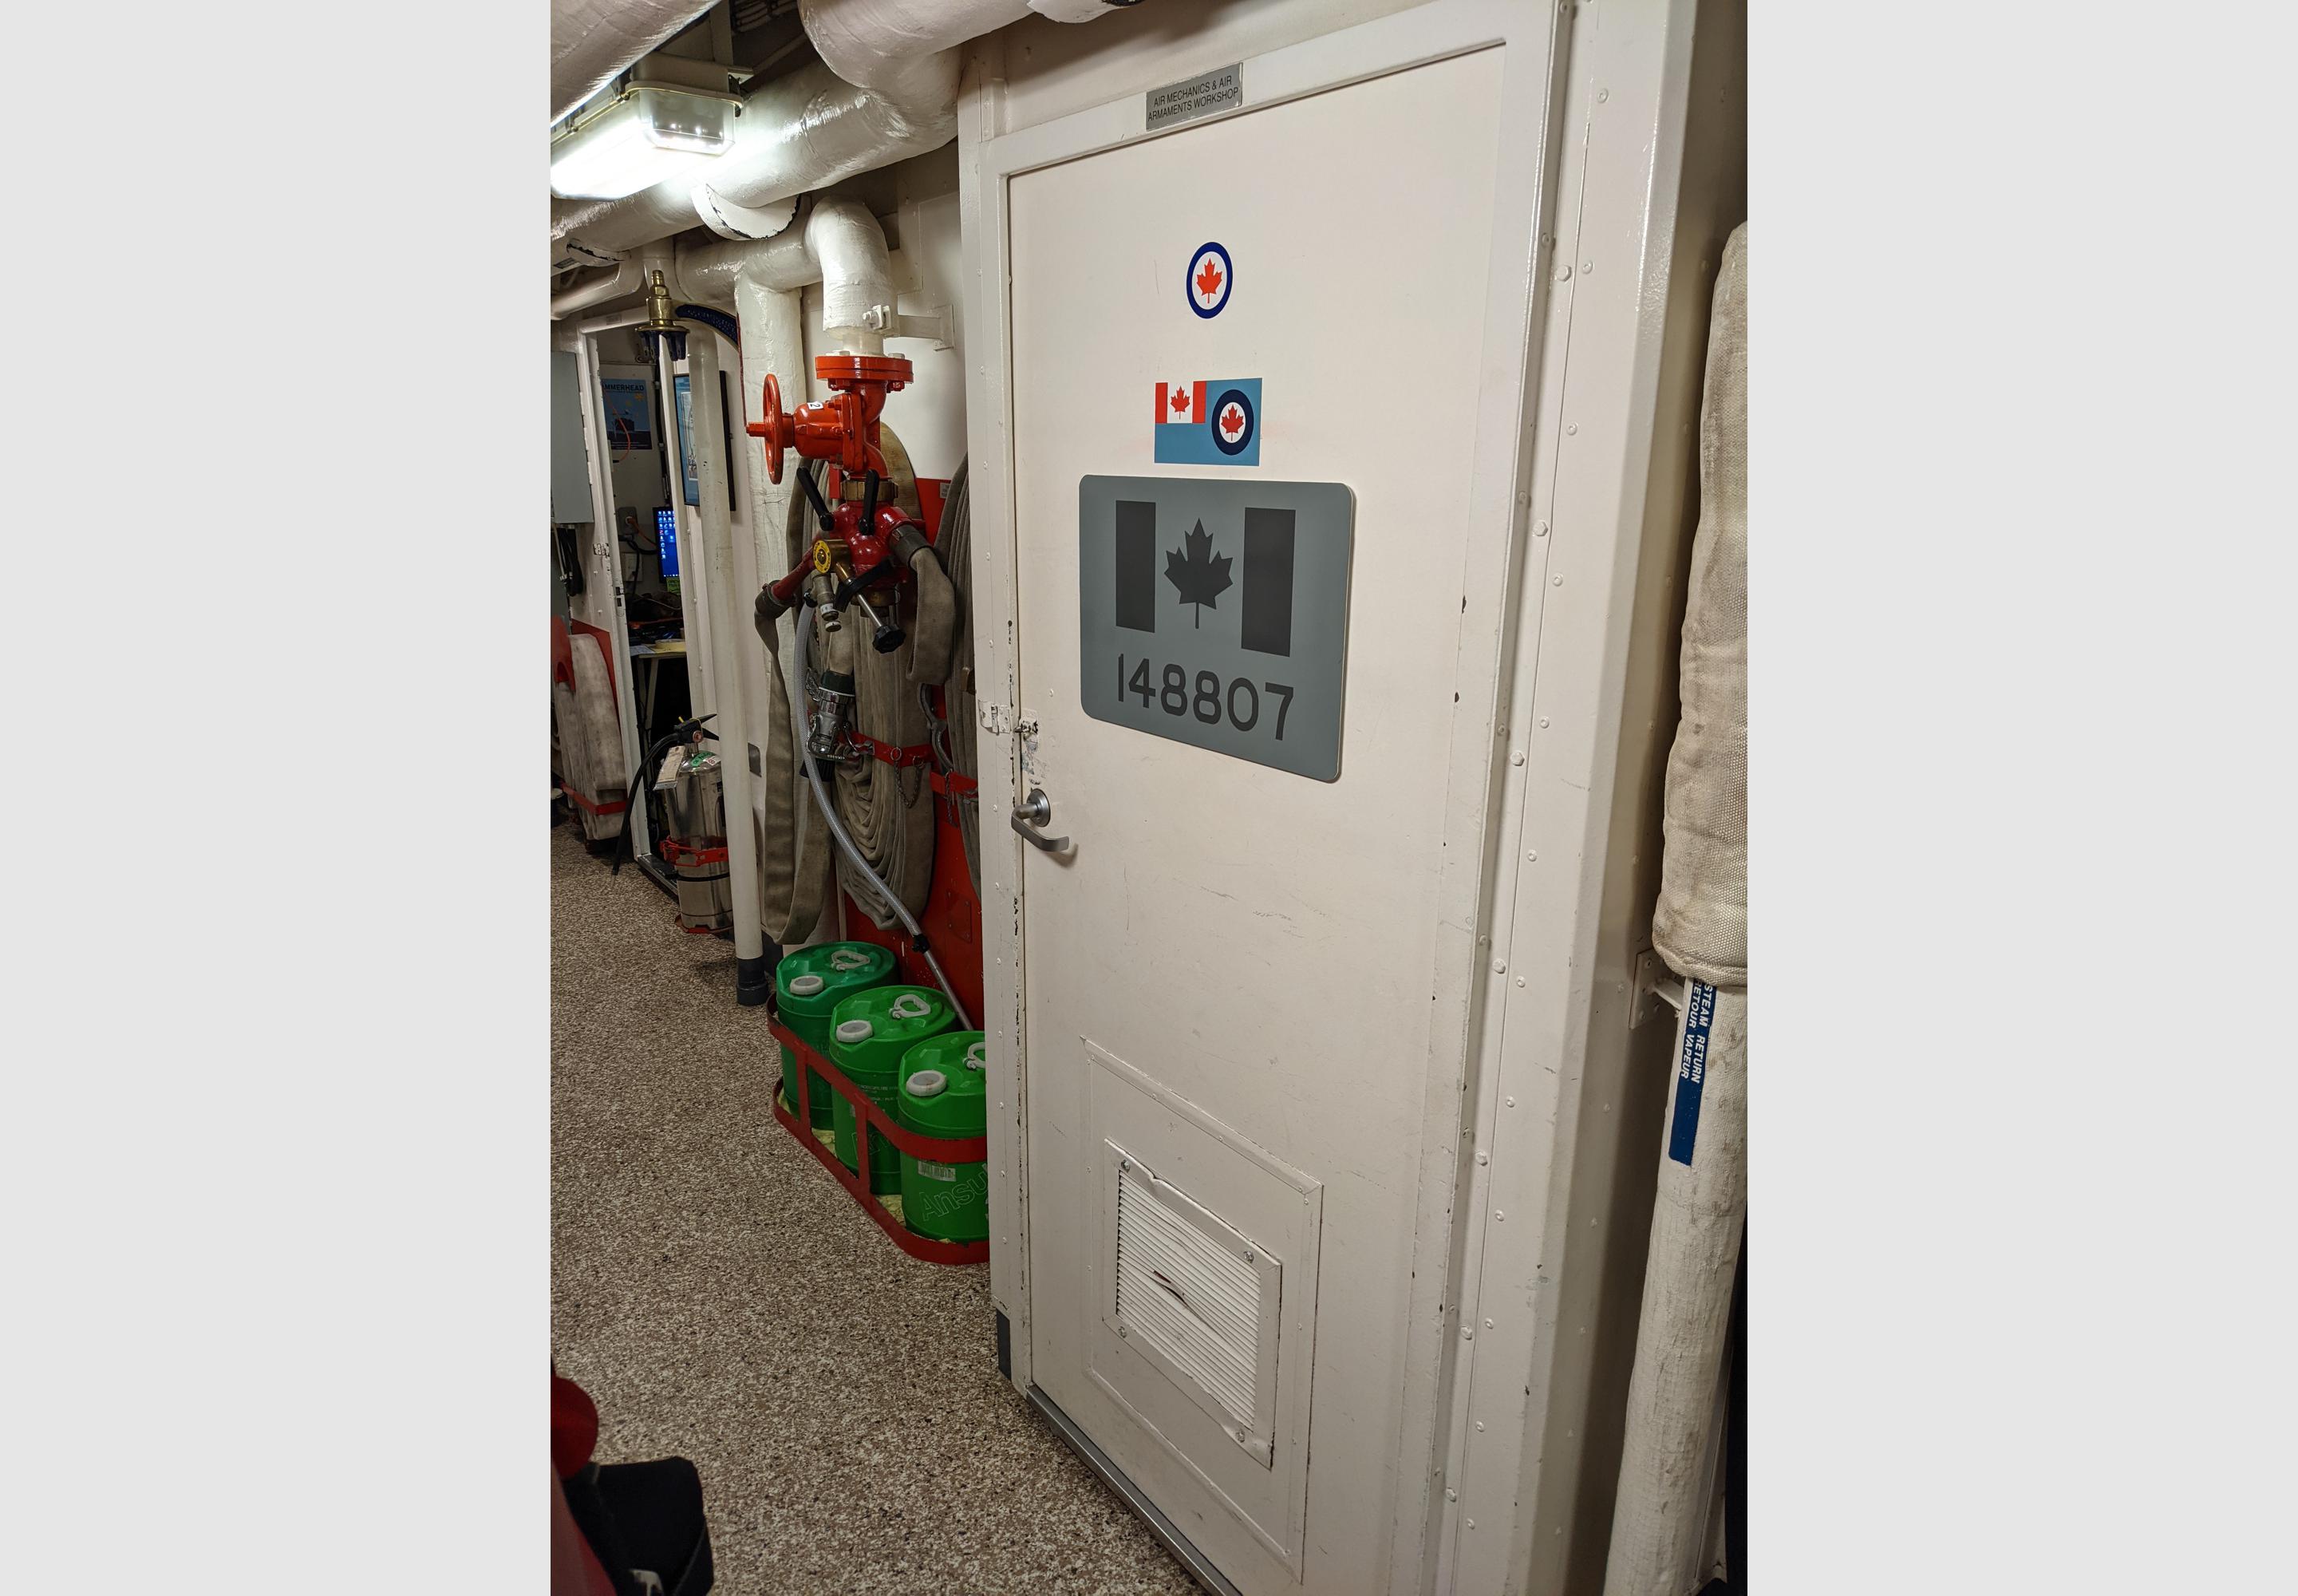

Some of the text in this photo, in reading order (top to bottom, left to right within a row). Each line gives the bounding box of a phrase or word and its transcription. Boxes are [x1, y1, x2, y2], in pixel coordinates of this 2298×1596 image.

[1147, 86, 1238, 121] ARMAMENTS WORKSHOP
[1154, 75, 1232, 107] AIR MECHANICS & AIR
[1118, 654, 1293, 741] 148807
[1680, 1034, 1695, 1080] VAPEUR
[1691, 983, 1713, 1084] STEAM RETURN
[919, 1164, 988, 1221] Ansu
